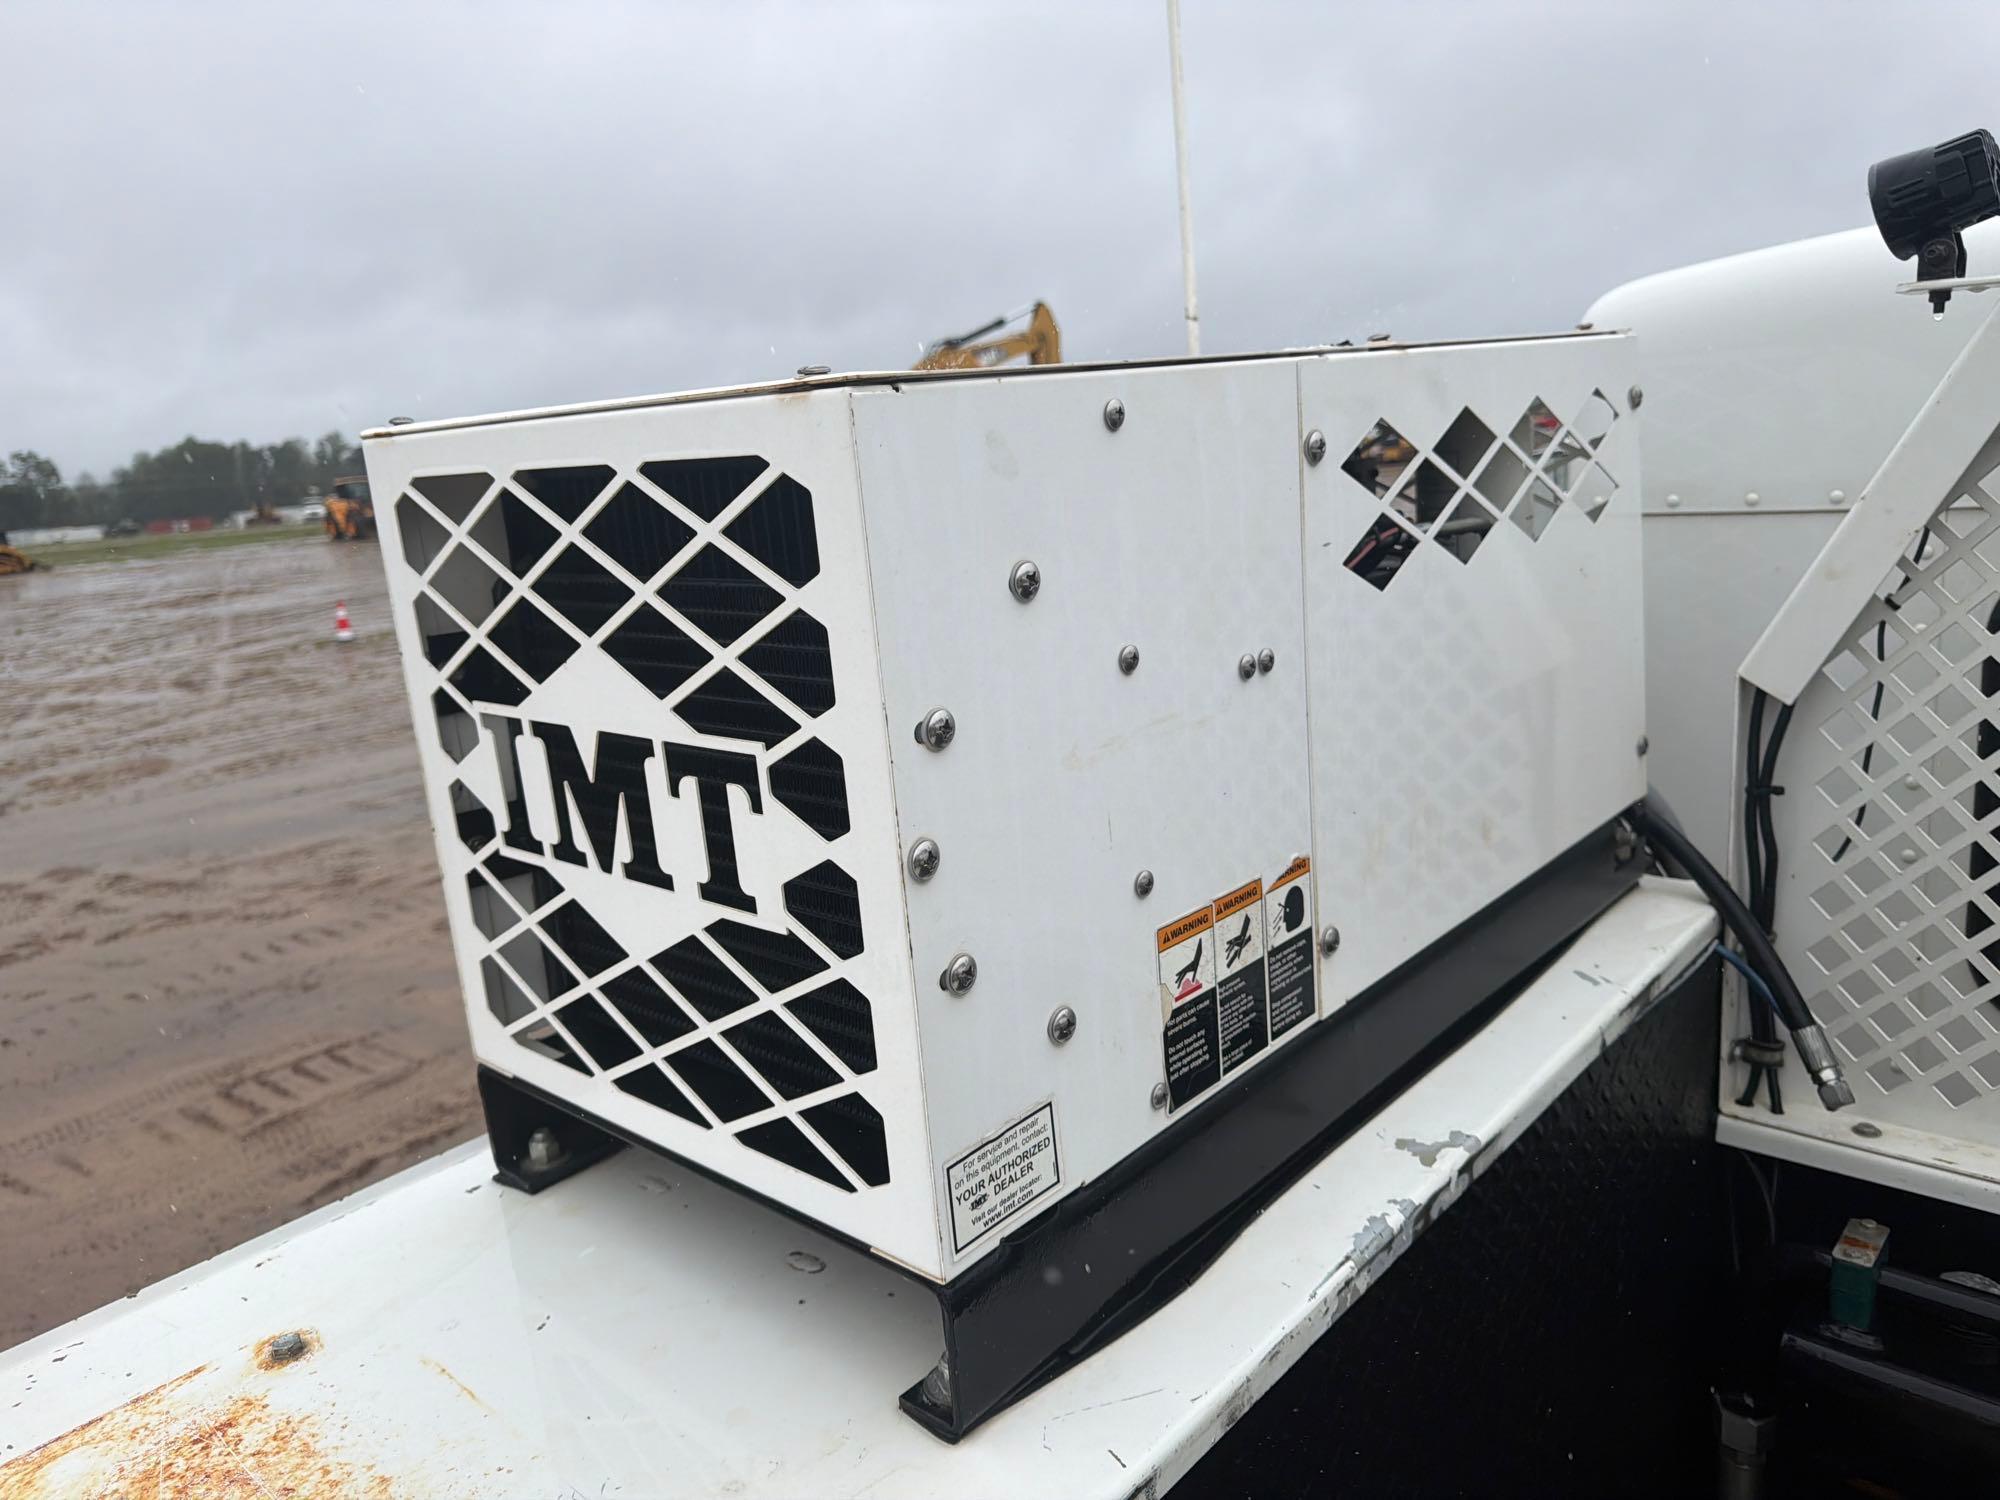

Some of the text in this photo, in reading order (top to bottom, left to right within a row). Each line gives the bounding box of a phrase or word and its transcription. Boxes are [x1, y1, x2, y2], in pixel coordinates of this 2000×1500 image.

[479, 712, 763, 915] IMT
[1222, 886, 1258, 912] WARNING
[1170, 914, 1209, 939] WARNING
[955, 1179, 965, 1190] on
[966, 1168, 980, 1183] this
[1021, 1123, 1048, 1145] contact:
[963, 1116, 1039, 1172] For service and repair
[955, 1136, 1050, 1206] YOUR AUTHORIZED
[970, 1161, 1034, 1211] IMT DEALER
[971, 1212, 986, 1226] Visit
[987, 1202, 998, 1215] our
[999, 1190, 1018, 1208] dealer
[983, 1189, 1033, 1228] www.imt.com
